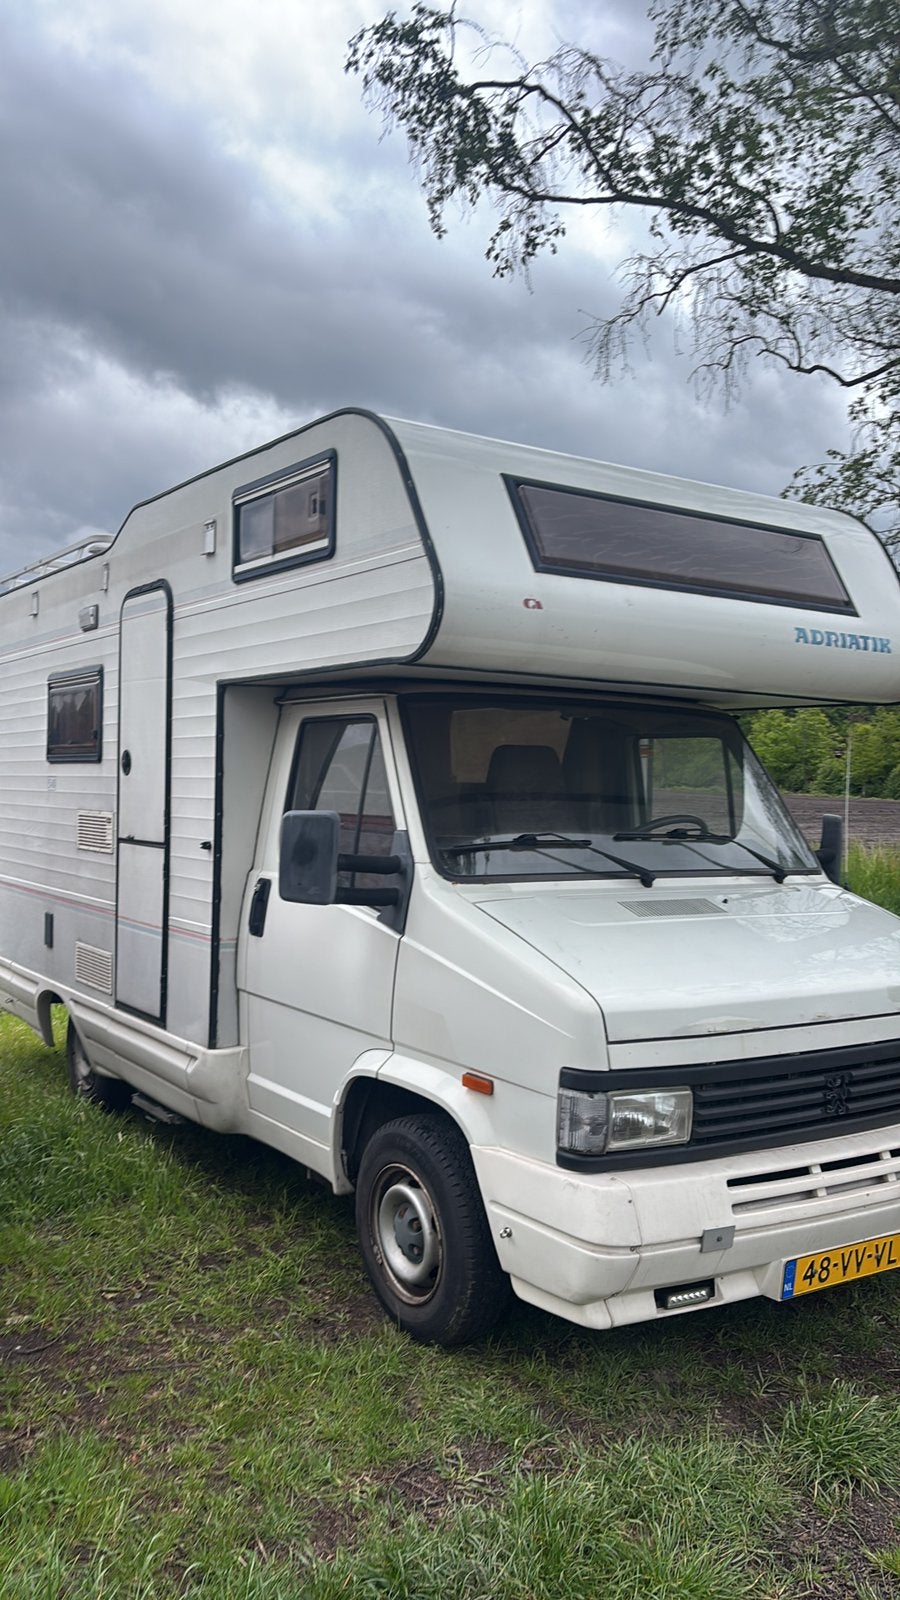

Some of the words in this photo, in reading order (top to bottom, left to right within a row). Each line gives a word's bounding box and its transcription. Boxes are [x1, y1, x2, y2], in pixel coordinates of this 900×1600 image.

[794, 626, 892, 654] ADRIATIK
[802, 1240, 897, 1286] 48-VV-VL
[783, 1282, 793, 1292] NL
